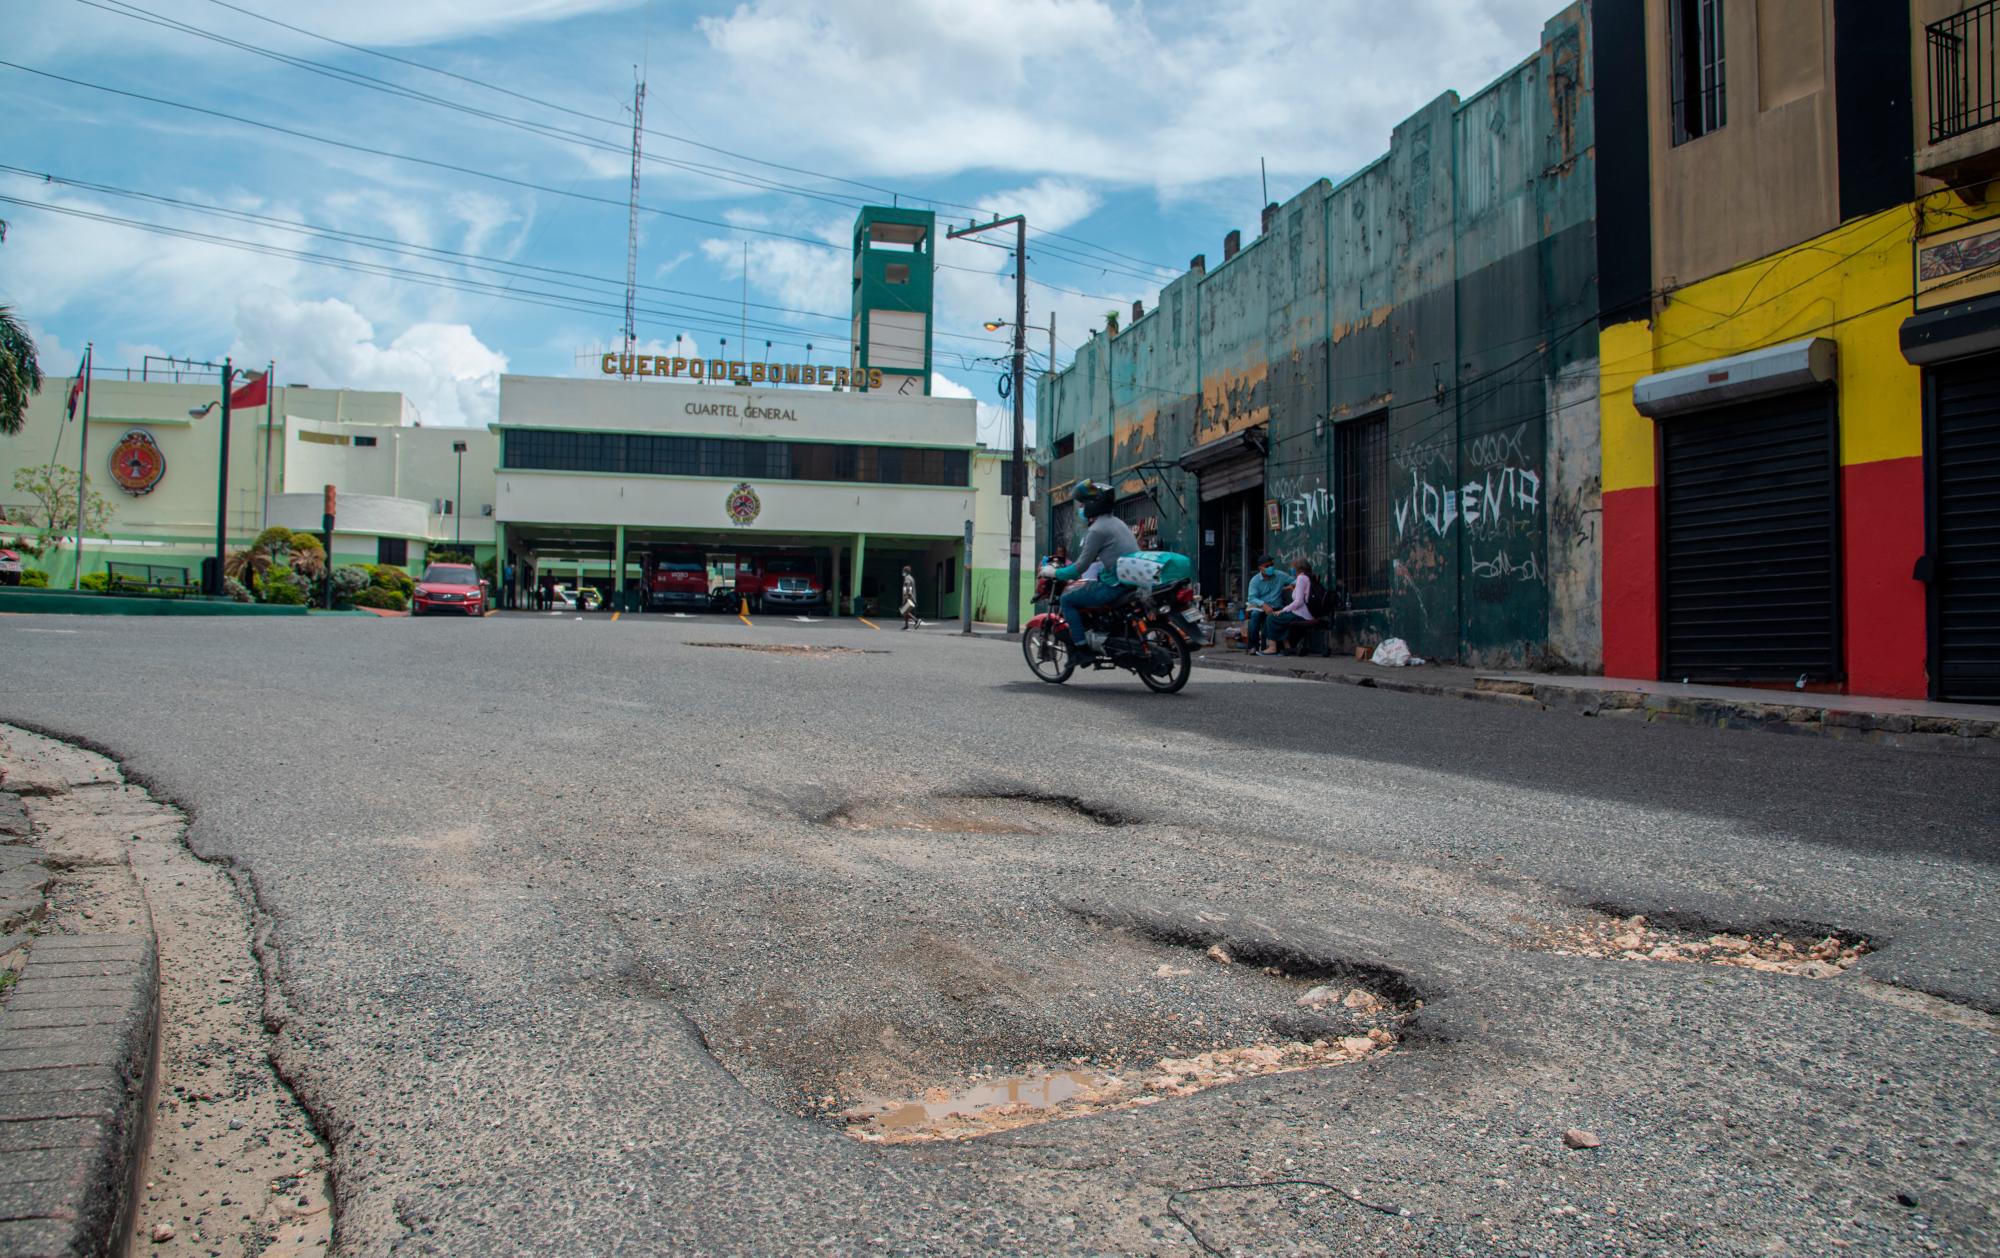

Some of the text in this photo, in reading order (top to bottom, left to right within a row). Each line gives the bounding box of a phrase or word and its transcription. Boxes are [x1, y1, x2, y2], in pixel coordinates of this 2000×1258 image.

[602, 353, 883, 389] CUERPO DE BOMBEROS
[685, 402, 798, 421] CUARTEL GENERAL
